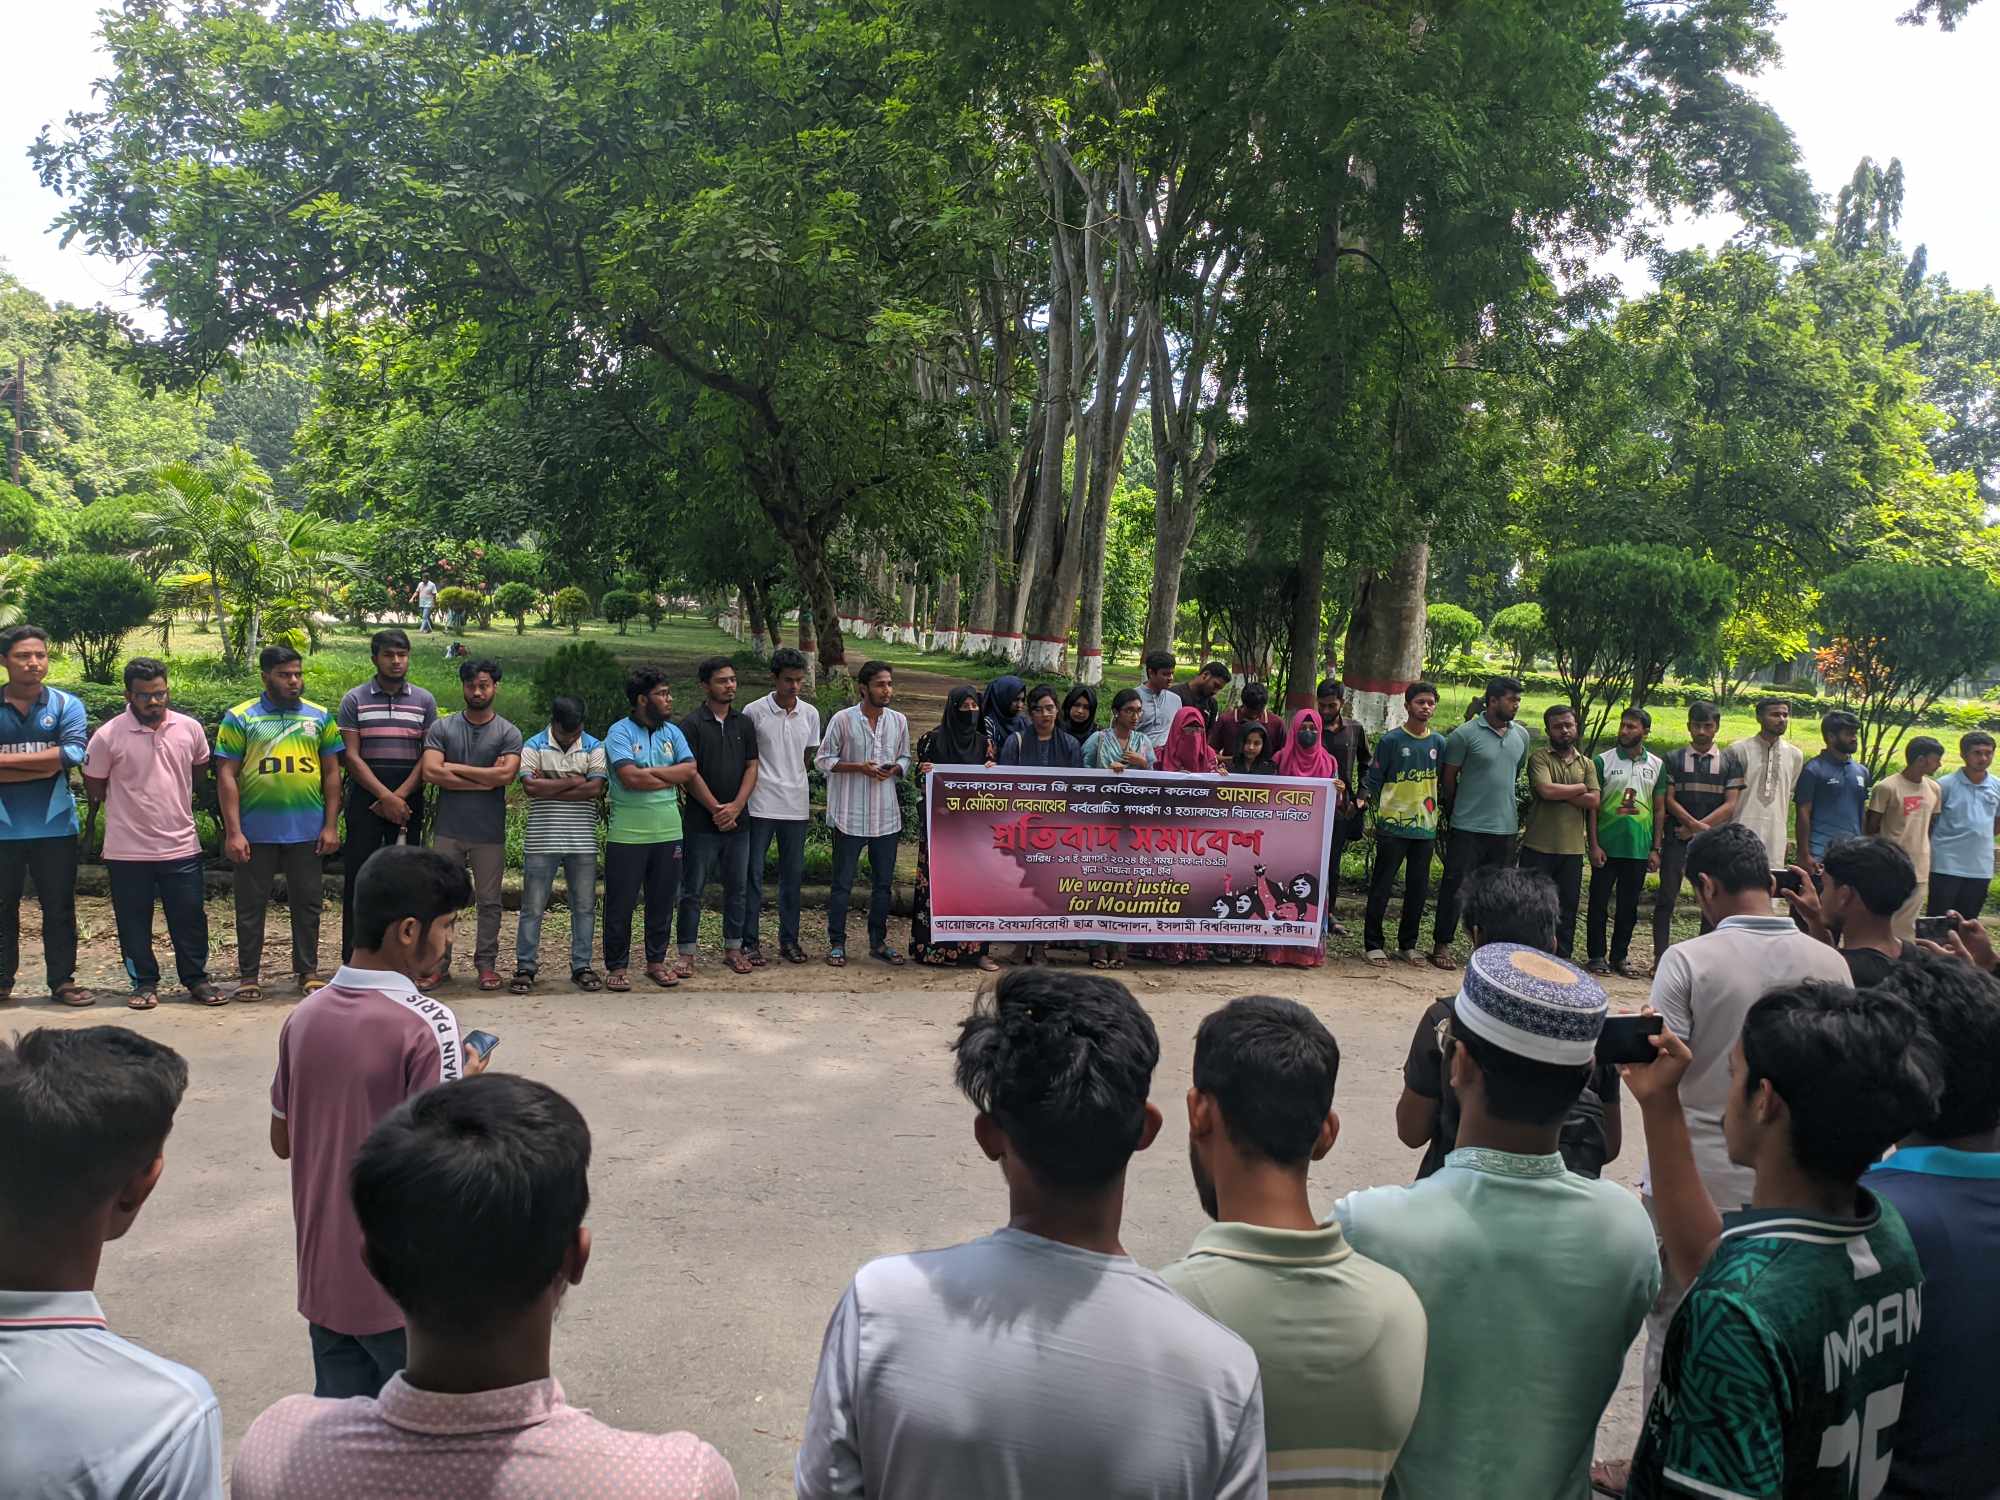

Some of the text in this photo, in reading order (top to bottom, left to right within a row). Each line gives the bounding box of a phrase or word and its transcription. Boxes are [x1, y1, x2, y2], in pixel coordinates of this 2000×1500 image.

[944, 780, 1314, 806] কলকাতার আর জি কর মেডিকেল কলেজে আমার বোন
[1012, 799, 1067, 813] দেবনাথের
[1069, 800, 1120, 814] বর্বরোচিত
[1124, 804, 1161, 816] গণধর্ষণ
[1163, 807, 1172, 816] ও
[1174, 806, 1228, 818] হত্যাকাণ্ডের
[1232, 806, 1273, 819] বিচারের
[1275, 808, 1311, 821] দাবিতে
[990, 812, 1264, 857] প্রতিবাদ সমাবেশ
[1058, 878, 1190, 898] We want justice
[1068, 896, 1181, 914] for Moumita
[998, 917, 1069, 930] বৈষম্যবিরোধী
[1073, 919, 1093, 930] ছাত্র
[1156, 919, 1195, 933] ইসলামী
[406, 994, 453, 1034] PARIS
[1823, 1280, 1922, 1393] IMRAN
